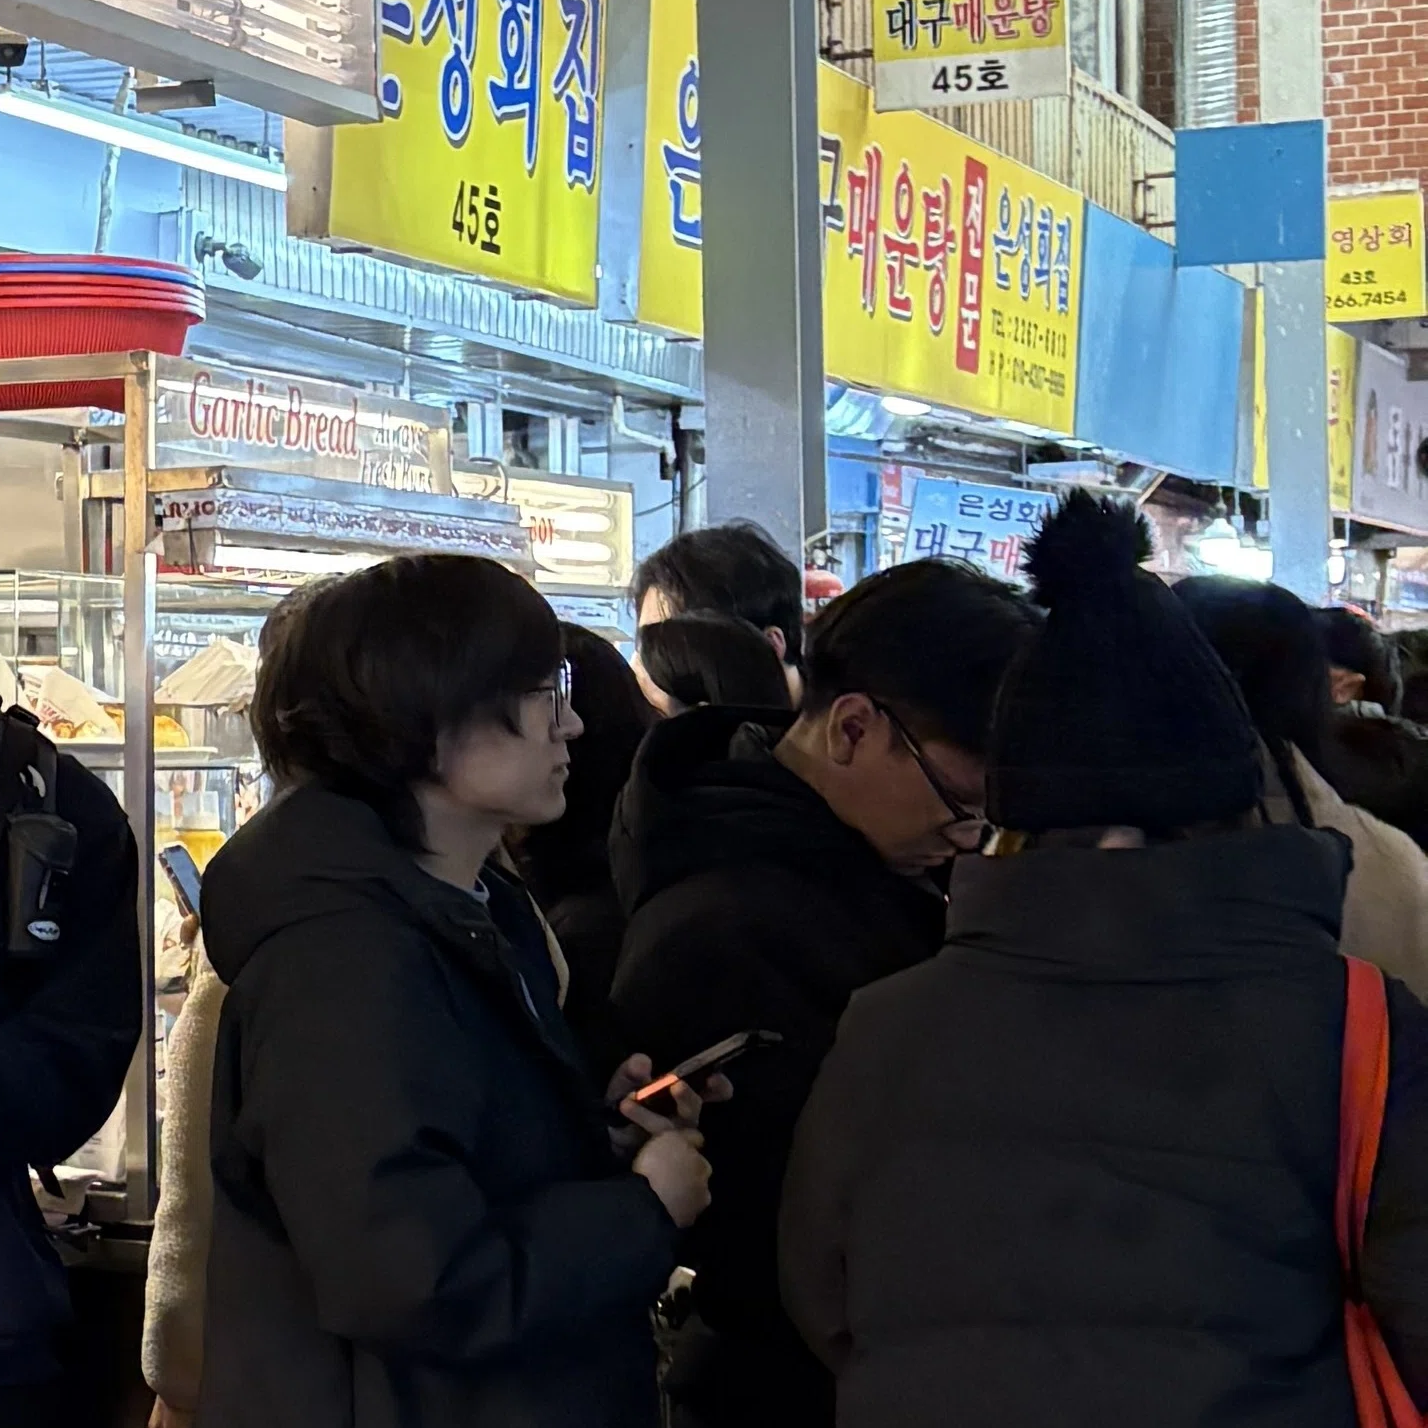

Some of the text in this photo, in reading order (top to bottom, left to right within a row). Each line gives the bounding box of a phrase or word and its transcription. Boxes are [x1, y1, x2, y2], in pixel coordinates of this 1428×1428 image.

[932, 59, 1009, 93] 45호
[452, 180, 502, 255] 45호
[993, 185, 1072, 315] 은성회집
[190, 372, 359, 458] Garlic Bread
